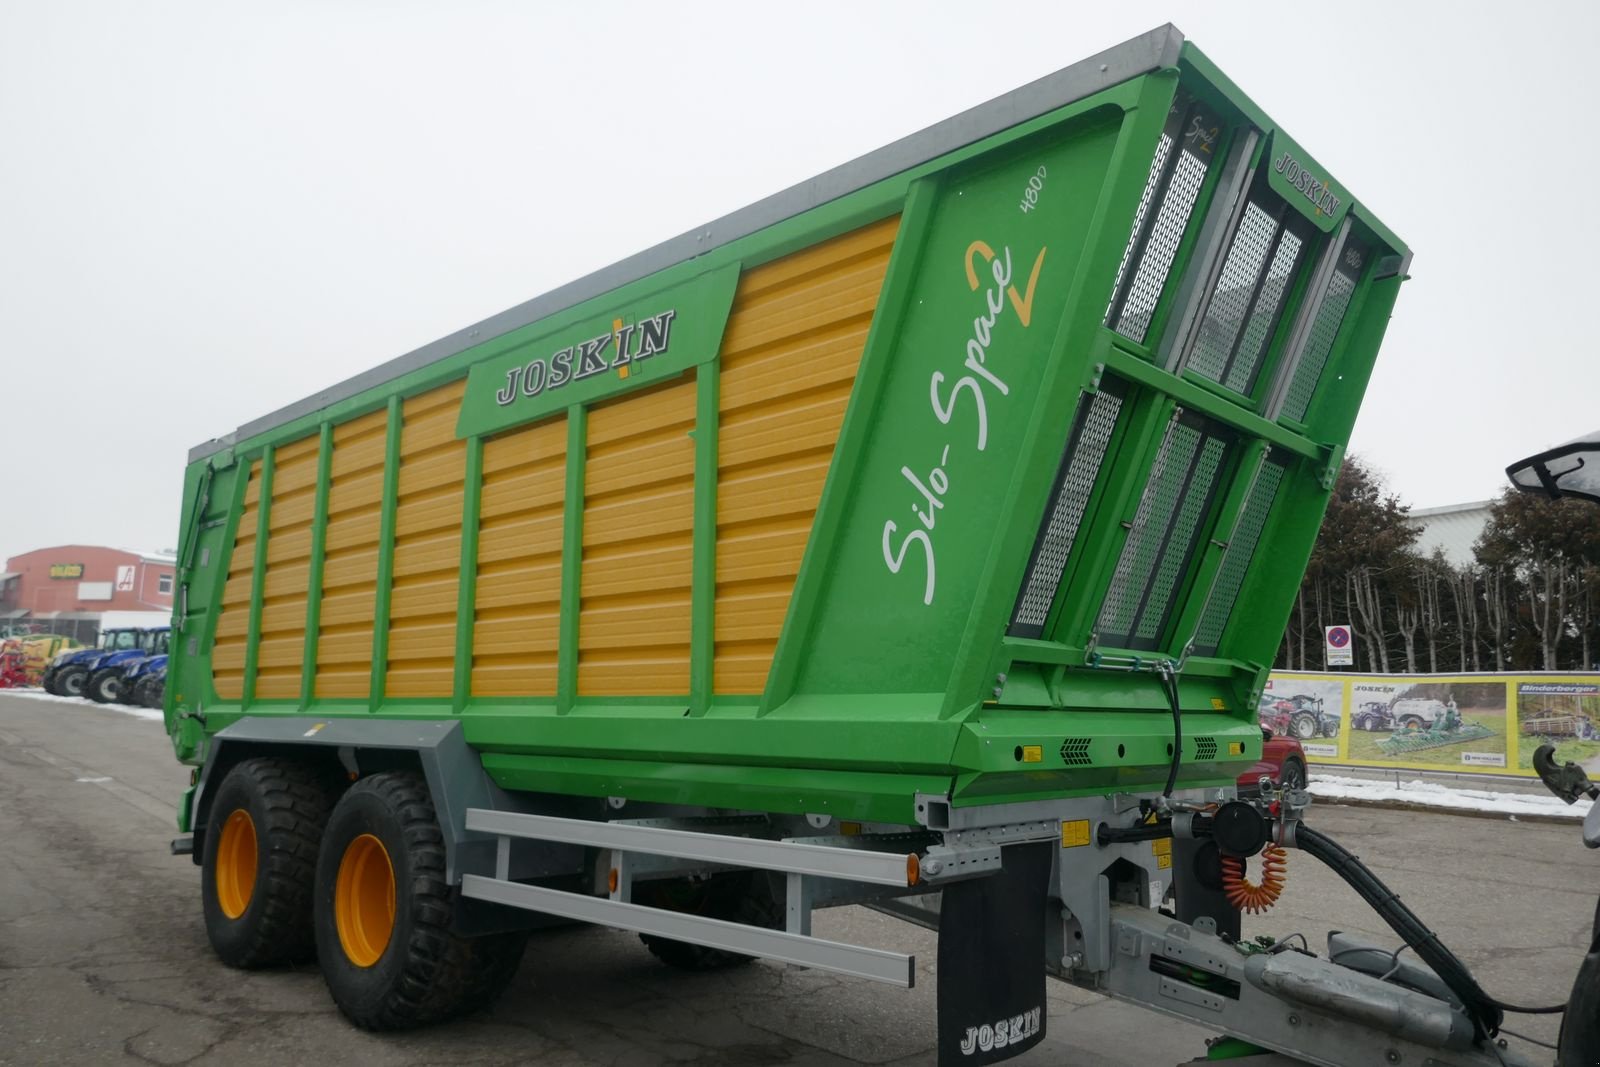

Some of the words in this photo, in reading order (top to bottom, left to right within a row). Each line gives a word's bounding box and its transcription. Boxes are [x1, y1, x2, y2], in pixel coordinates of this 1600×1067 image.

[1275, 151, 1341, 218] JOSKIN
[496, 309, 677, 405] JOSKIN
[1521, 684, 1597, 693] Binderberger
[960, 1006, 1041, 1055] JOSKIN
